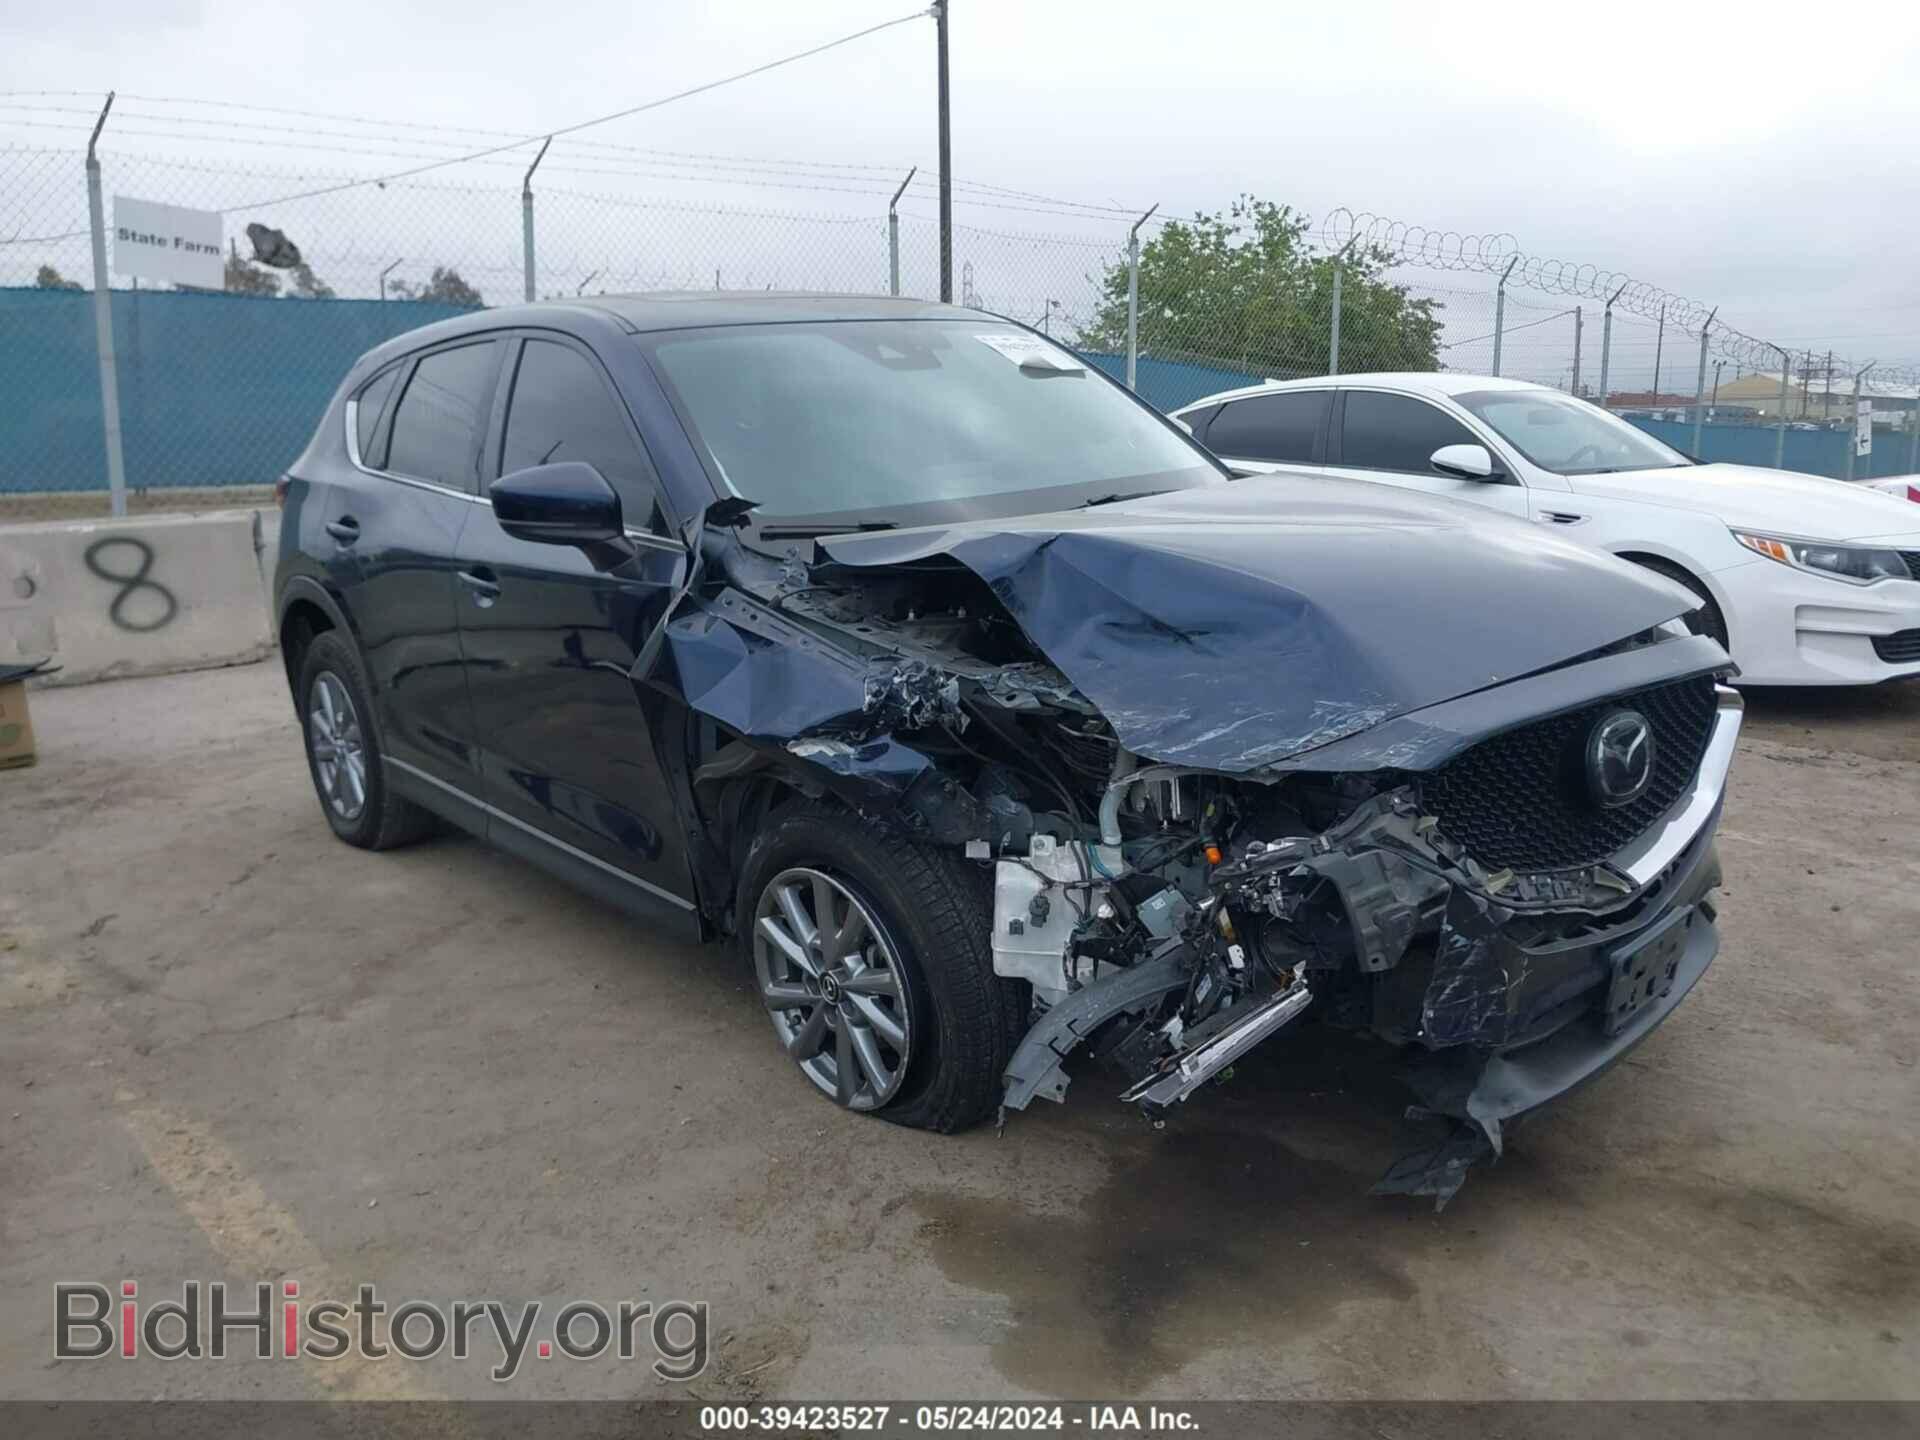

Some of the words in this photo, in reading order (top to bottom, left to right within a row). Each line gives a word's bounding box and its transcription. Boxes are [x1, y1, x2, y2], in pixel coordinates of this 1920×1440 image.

[118, 227, 168, 247] State
[174, 236, 220, 256] Farm
[85, 537, 178, 632] 8
